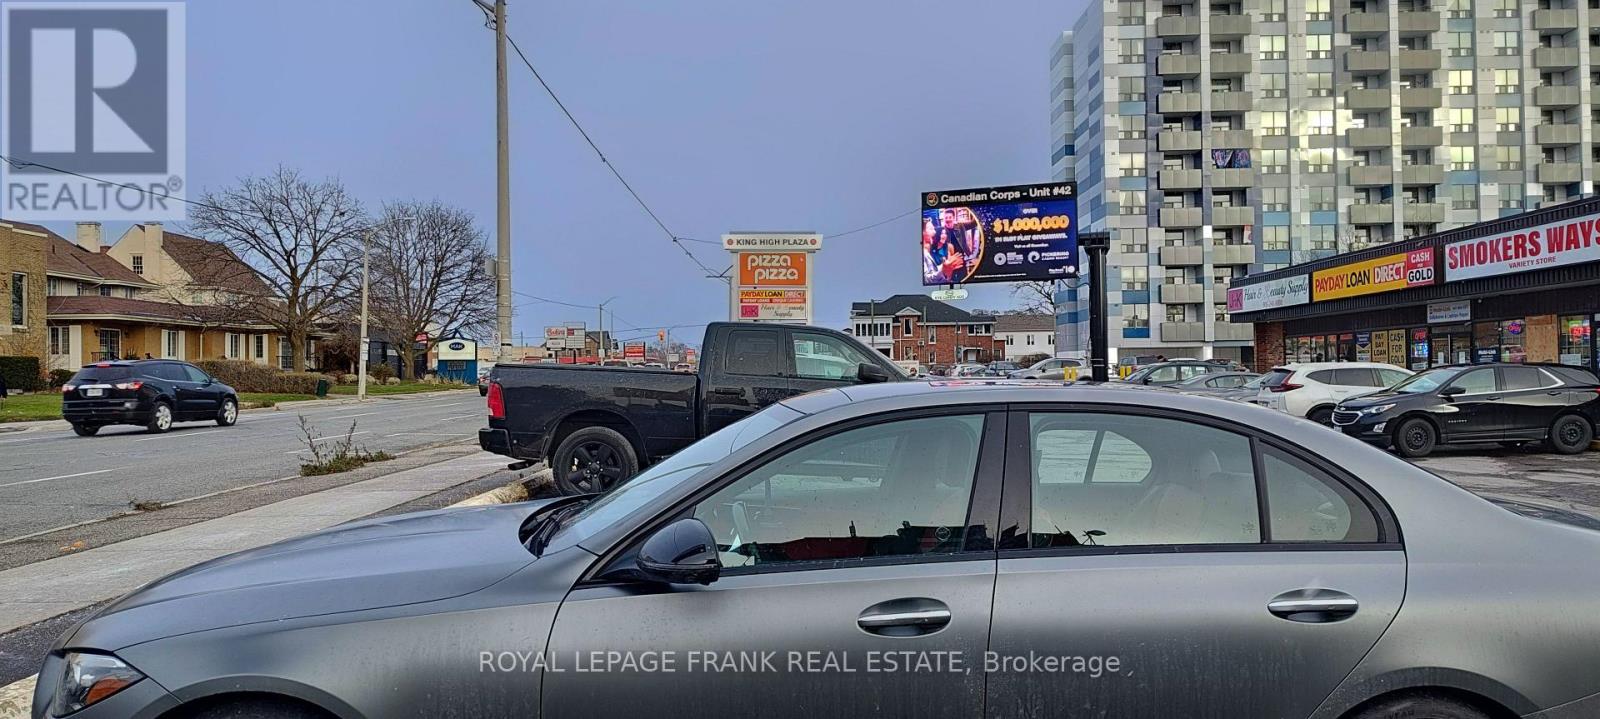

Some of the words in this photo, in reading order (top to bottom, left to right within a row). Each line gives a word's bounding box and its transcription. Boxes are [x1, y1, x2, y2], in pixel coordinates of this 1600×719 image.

[941, 192, 988, 203] Canadian
[990, 190, 1020, 201] Corps
[1029, 187, 1050, 198] Unit
[1052, 186, 1072, 196] #42
[993, 215, 1070, 233] $1,000,000
[1411, 252, 1430, 263] CASH
[1448, 230, 1540, 270] SMOKERS
[747, 255, 791, 270] pizza
[1509, 260, 1534, 268] VARIETY
[1536, 256, 1556, 264] STORE
[754, 268, 798, 284] pizza
[1316, 273, 1345, 294] PAYDAY
[1346, 269, 1370, 288] LOAN
[1374, 263, 1405, 283] DIRECT
[1408, 269, 1432, 282] GOLD
[1287, 277, 1307, 297] Supply
[1390, 332, 1404, 342] CASH
[1392, 345, 1402, 353] FOR
[1391, 356, 1404, 364] GOLD
